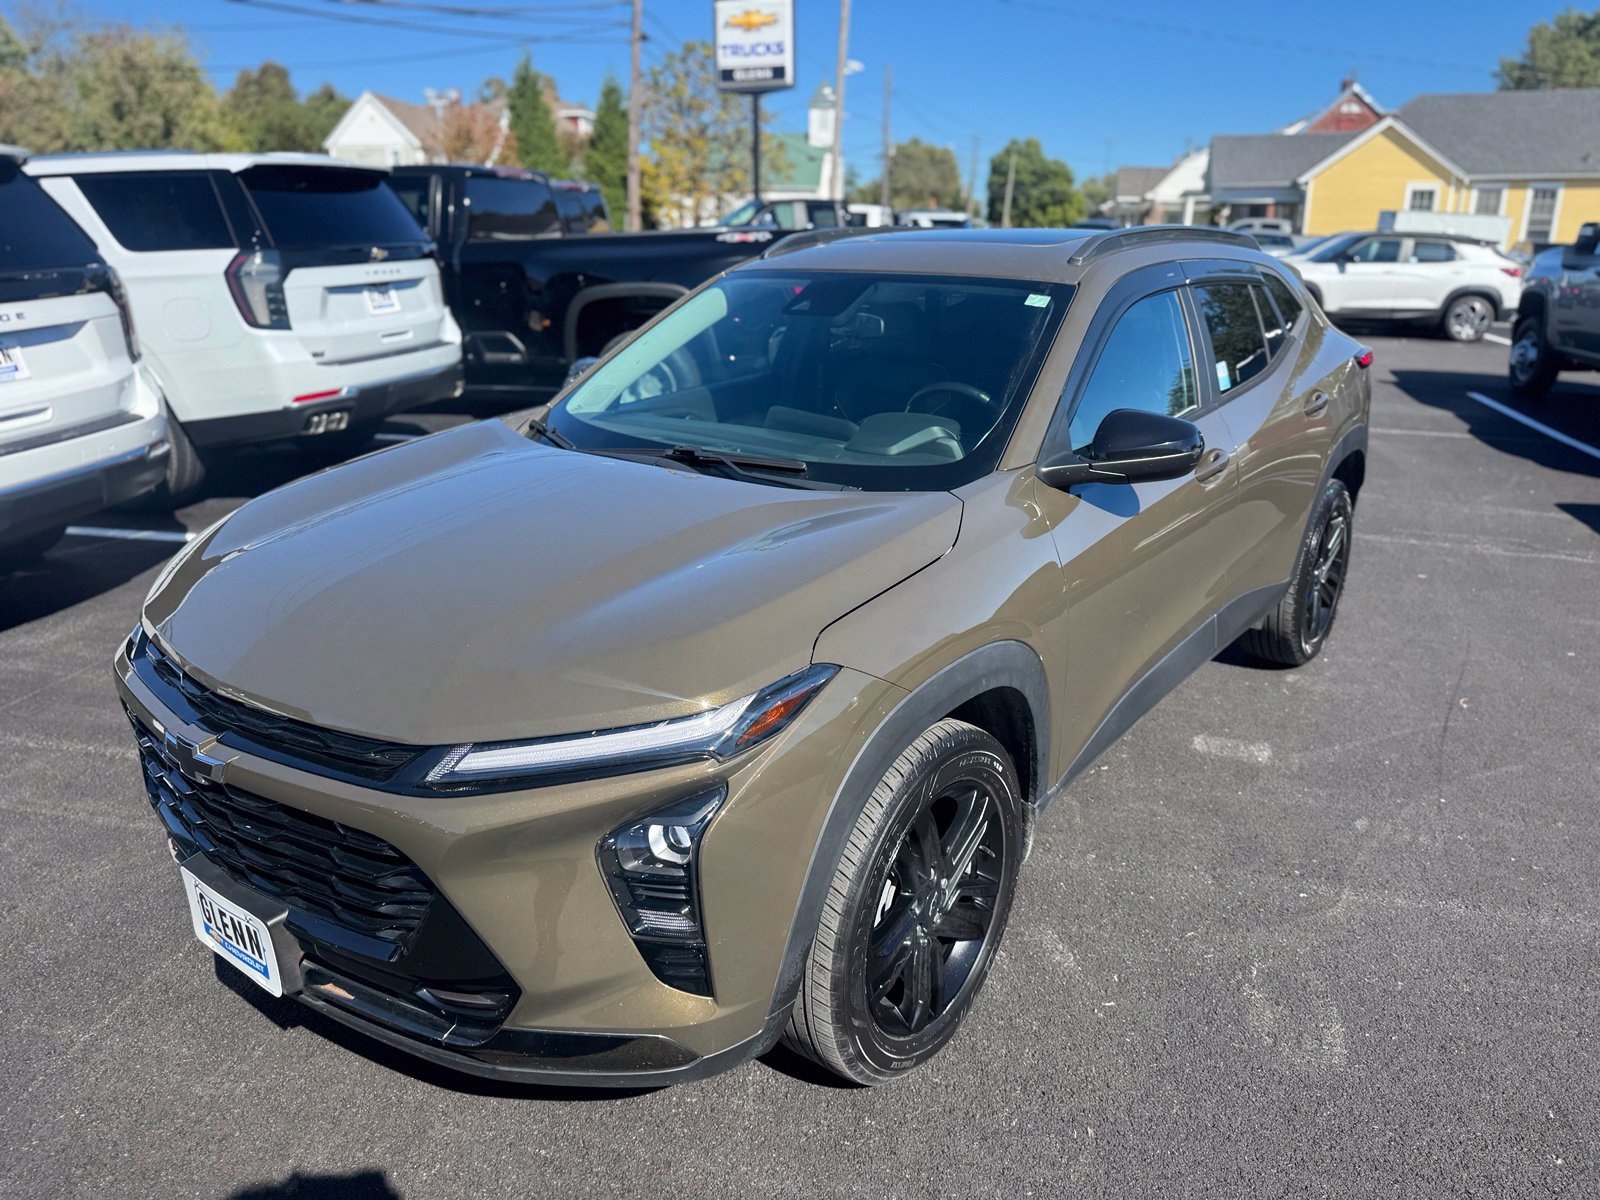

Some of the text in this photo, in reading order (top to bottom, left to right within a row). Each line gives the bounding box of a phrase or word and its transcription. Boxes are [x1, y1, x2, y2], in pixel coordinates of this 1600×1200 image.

[721, 41, 785, 57] TRUCKS
[198, 892, 264, 961] GLENN
[224, 941, 265, 973] CHEVROLET
